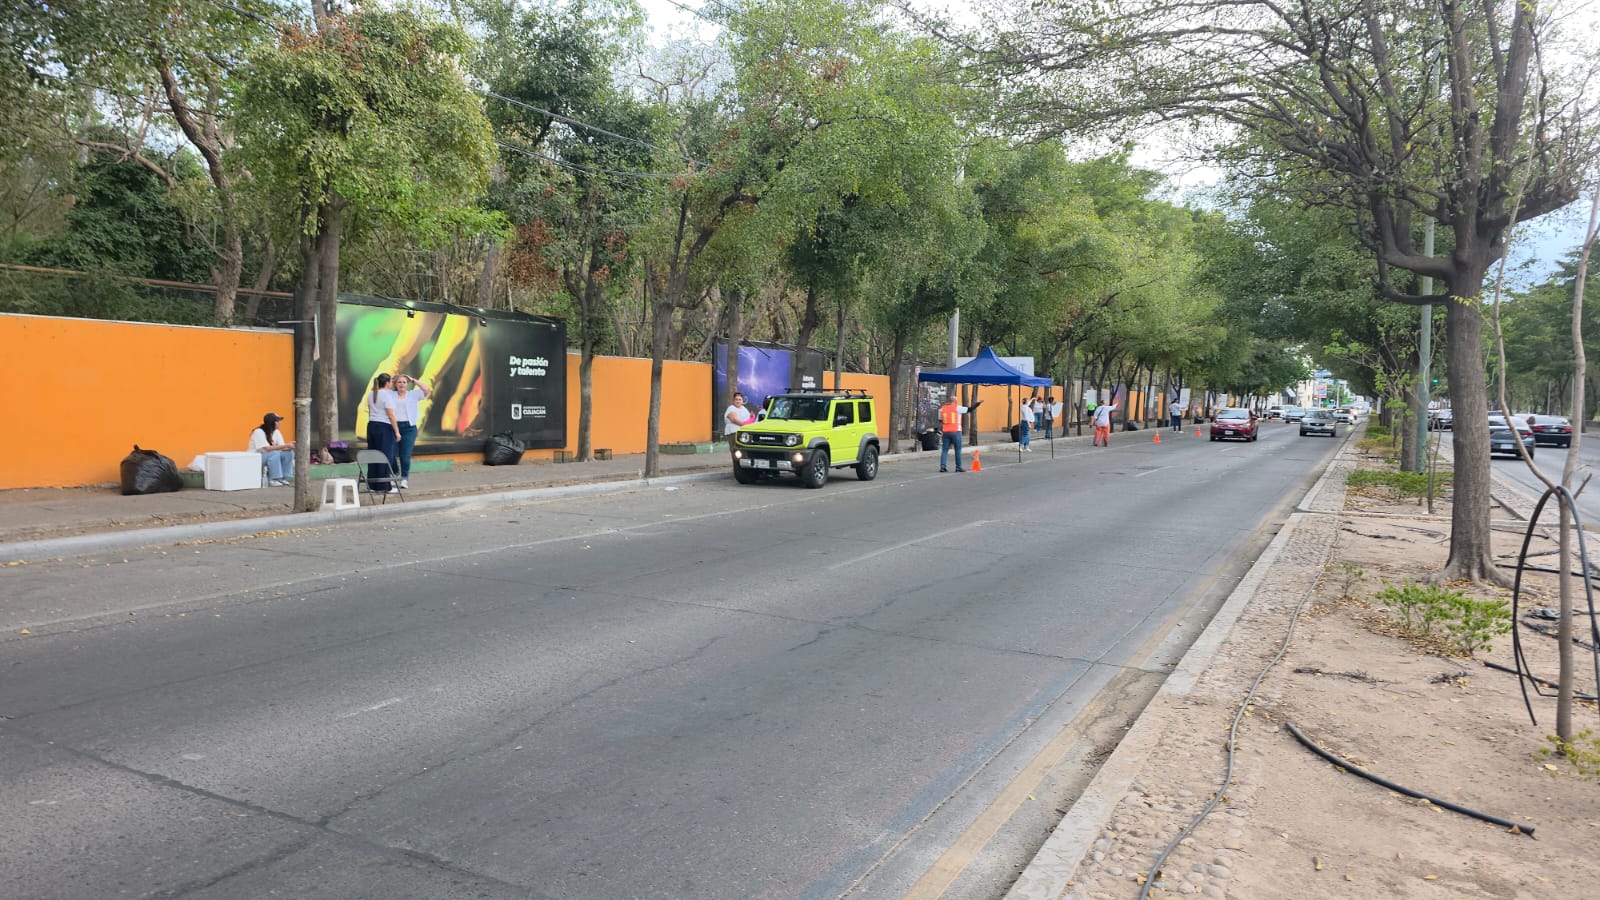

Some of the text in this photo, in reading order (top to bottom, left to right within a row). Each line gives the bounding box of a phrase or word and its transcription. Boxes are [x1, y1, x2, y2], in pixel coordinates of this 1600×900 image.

[510, 356, 548, 367] De pasión
[510, 366, 546, 376] y talento
